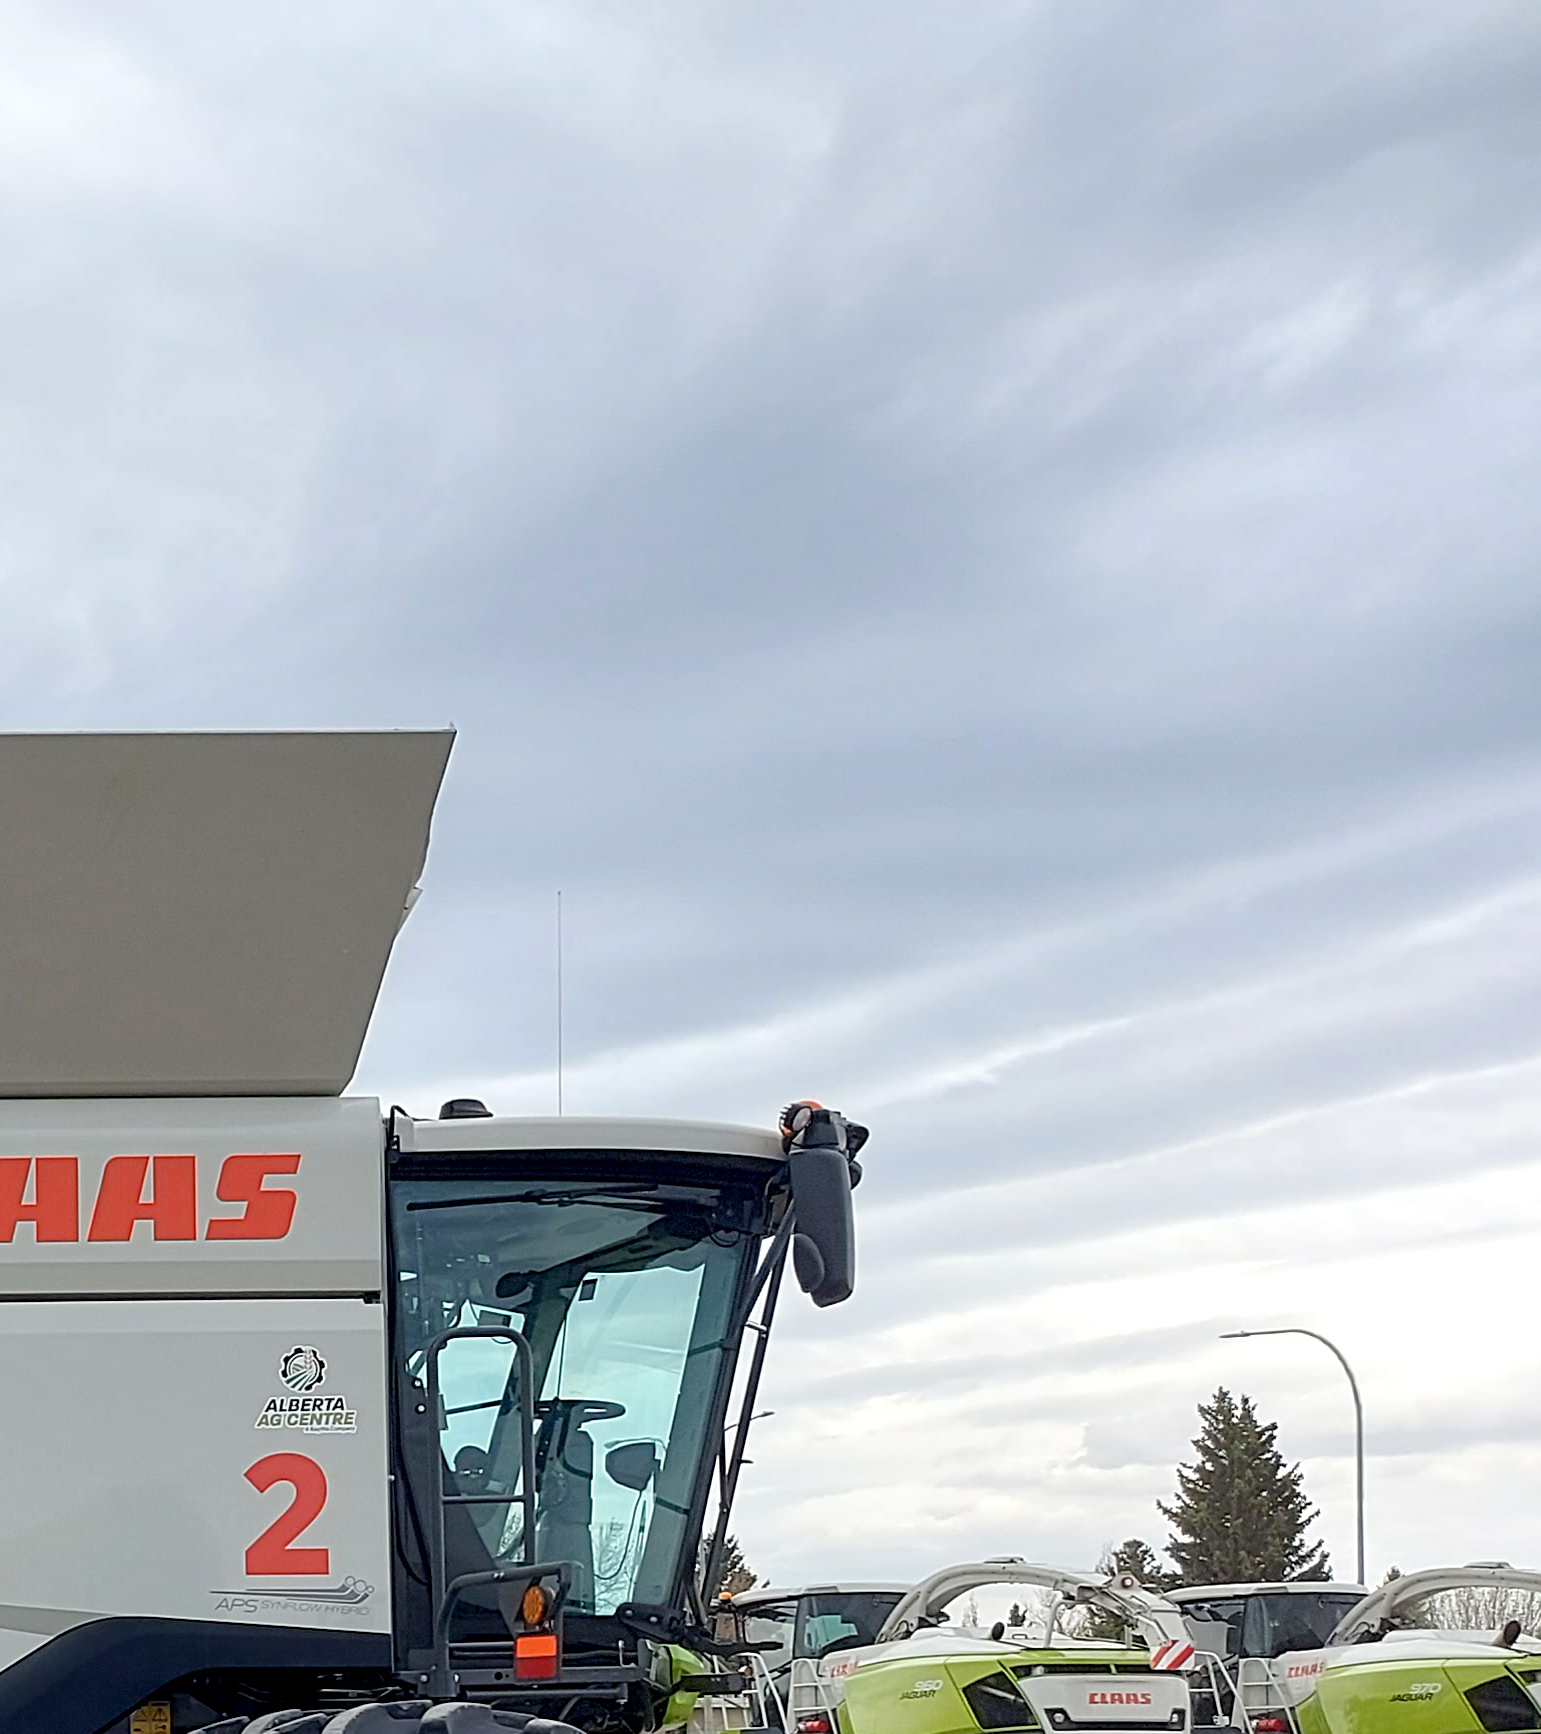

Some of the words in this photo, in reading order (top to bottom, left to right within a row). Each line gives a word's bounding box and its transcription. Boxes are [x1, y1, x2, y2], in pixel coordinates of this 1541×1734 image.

[264, 1397, 345, 1412] ALBERTA
[257, 1413, 283, 1426] AG
[287, 1411, 355, 1426] CENTRE
[243, 1452, 329, 1575] 2
[215, 1598, 259, 1613] APS
[260, 1600, 324, 1613] SYNFLOW
[1410, 1683, 1442, 1694] 970
[1088, 1692, 1152, 1705] CLAAS
[1389, 1692, 1434, 1702] JAGUAR
